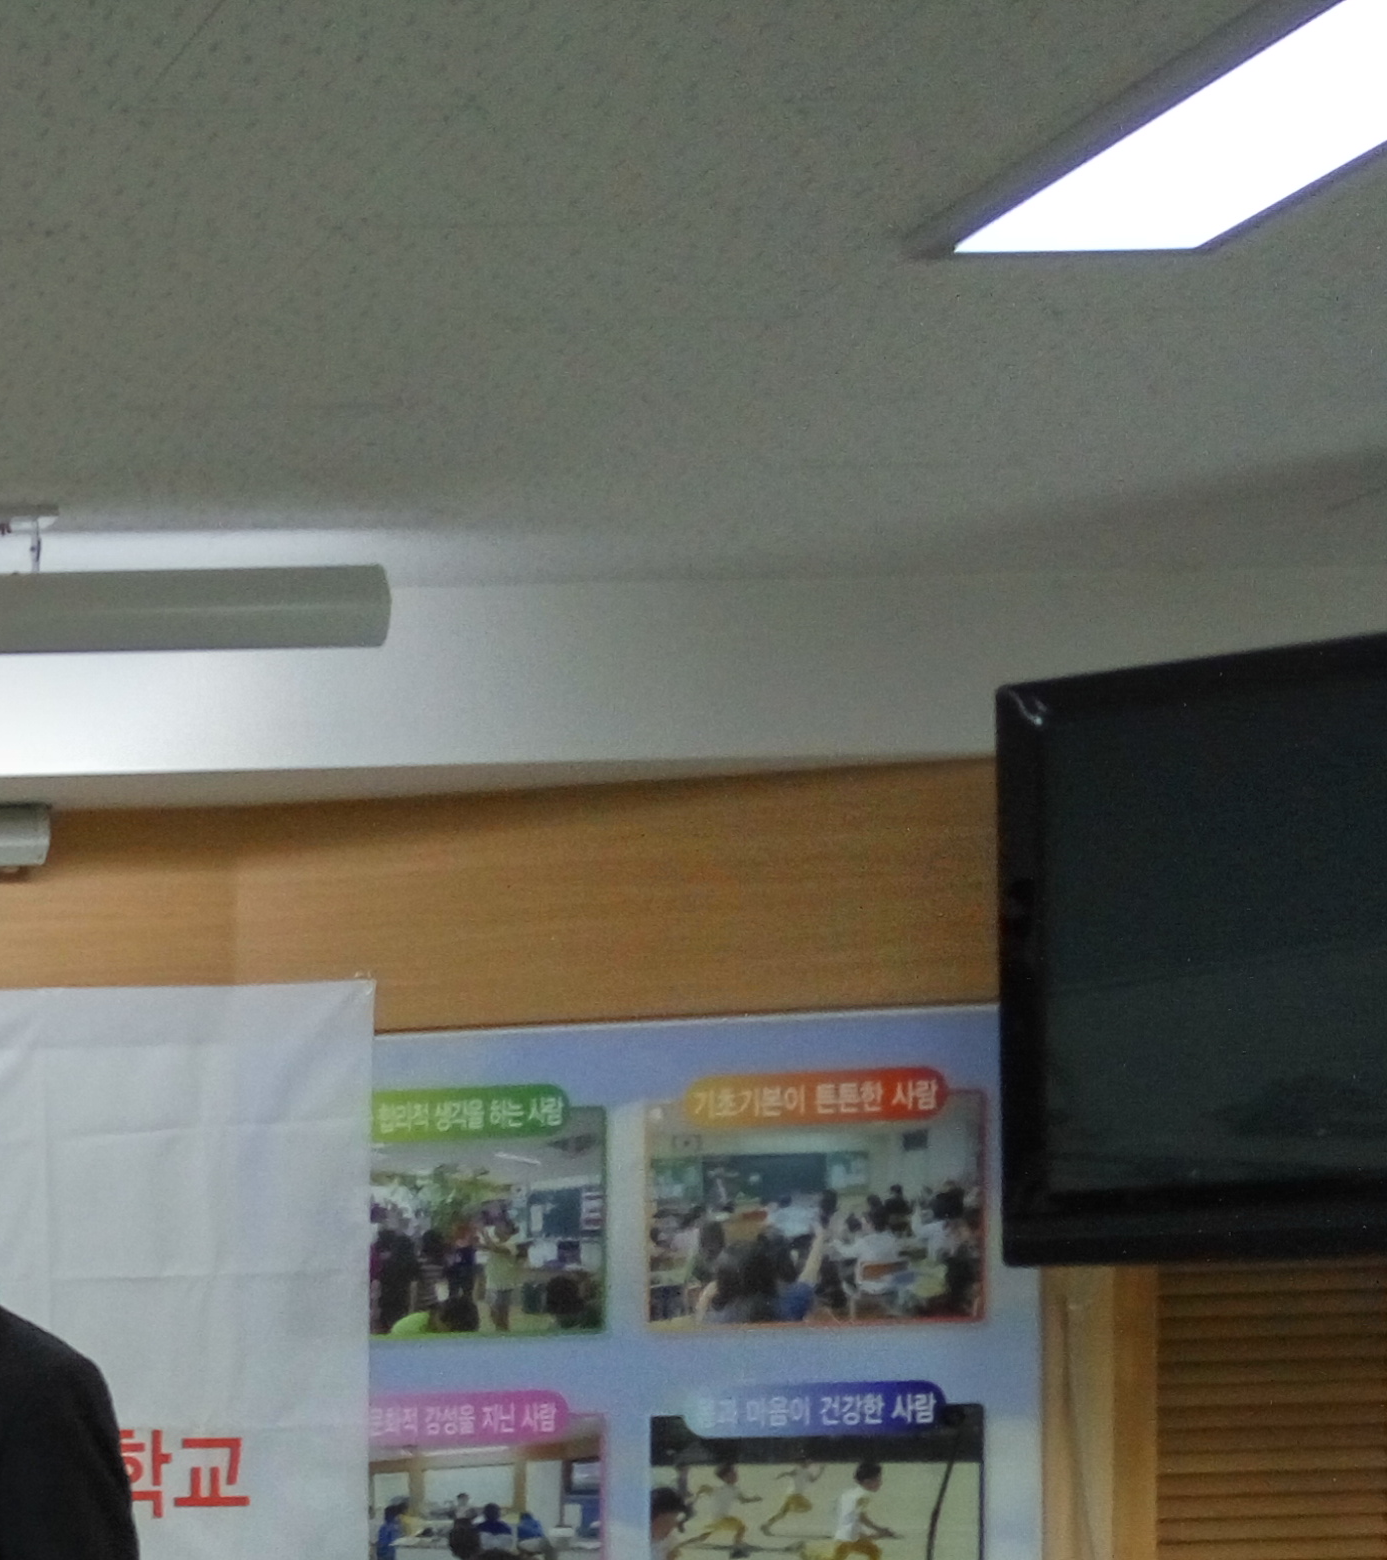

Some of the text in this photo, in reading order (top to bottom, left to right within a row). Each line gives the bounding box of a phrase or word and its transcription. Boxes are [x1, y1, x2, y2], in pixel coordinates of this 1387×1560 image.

[434, 1099, 485, 1132] 생각을
[489, 1098, 525, 1129] 하는
[528, 1096, 565, 1128] 사람
[693, 1079, 938, 1119] 기초기본이 튼튼한 사람
[425, 1404, 475, 1436] 감성을
[482, 1402, 516, 1434] 지닌
[521, 1402, 557, 1433] 사람
[820, 1394, 883, 1426] 건강한
[891, 1393, 936, 1425] 사람
